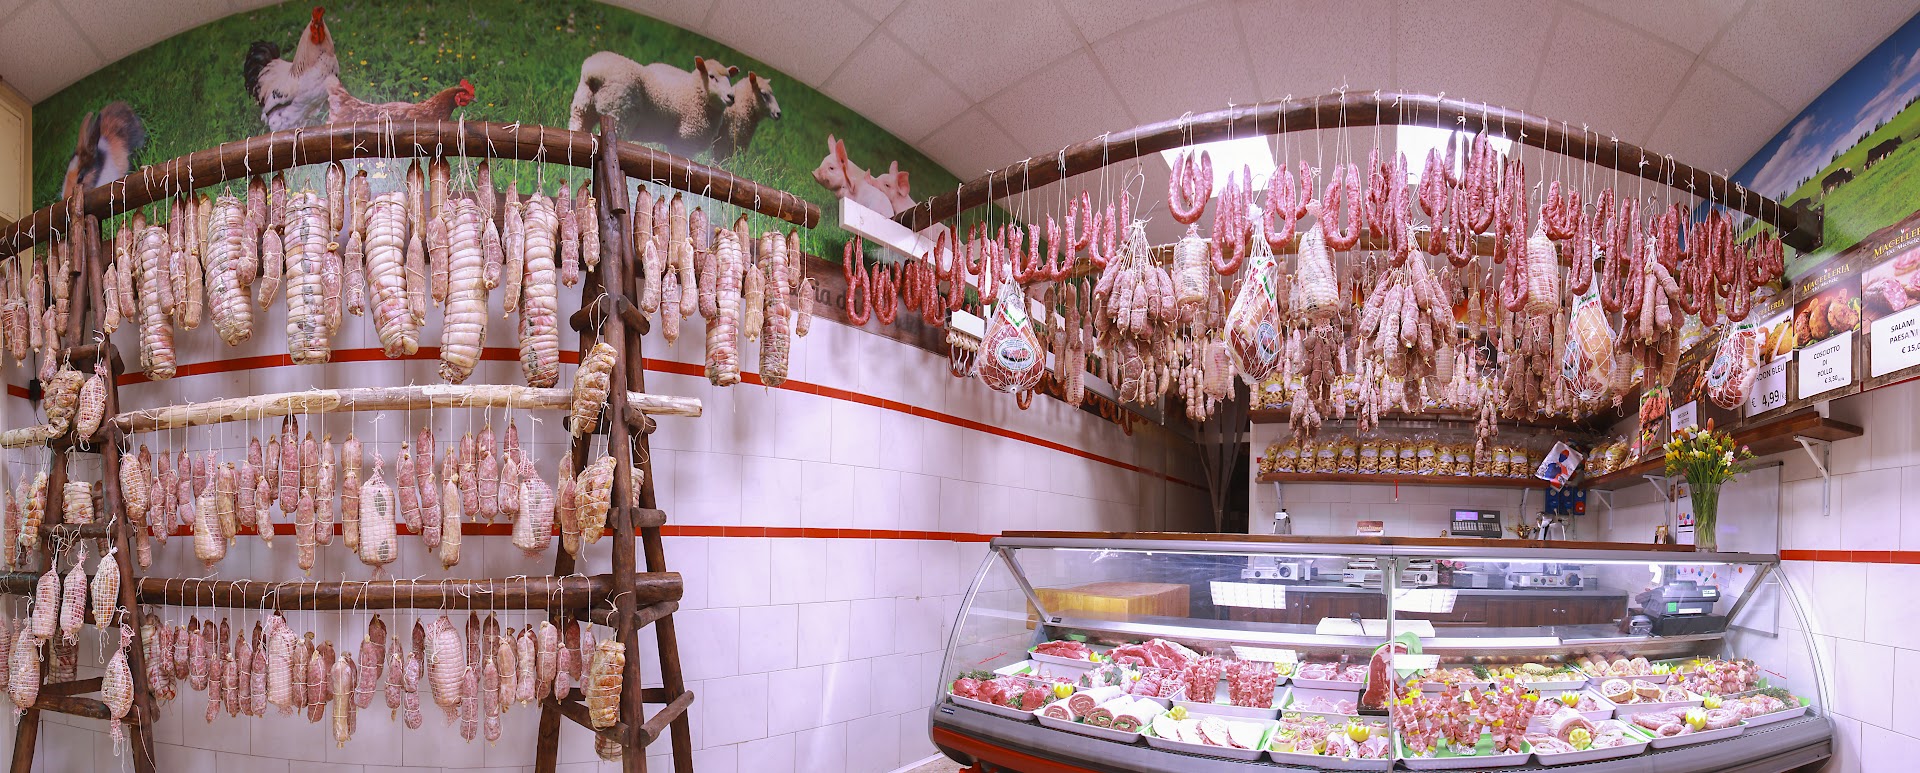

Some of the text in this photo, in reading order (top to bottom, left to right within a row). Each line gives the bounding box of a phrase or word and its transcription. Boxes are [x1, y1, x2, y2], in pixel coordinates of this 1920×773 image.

[1803, 264, 1850, 293] MACELLERIA
[1890, 318, 1915, 333] SALAMI
[1813, 344, 1841, 360] COSCIOTTO
[1771, 363, 1785, 376] BLEU
[1817, 367, 1833, 378] POLLO
